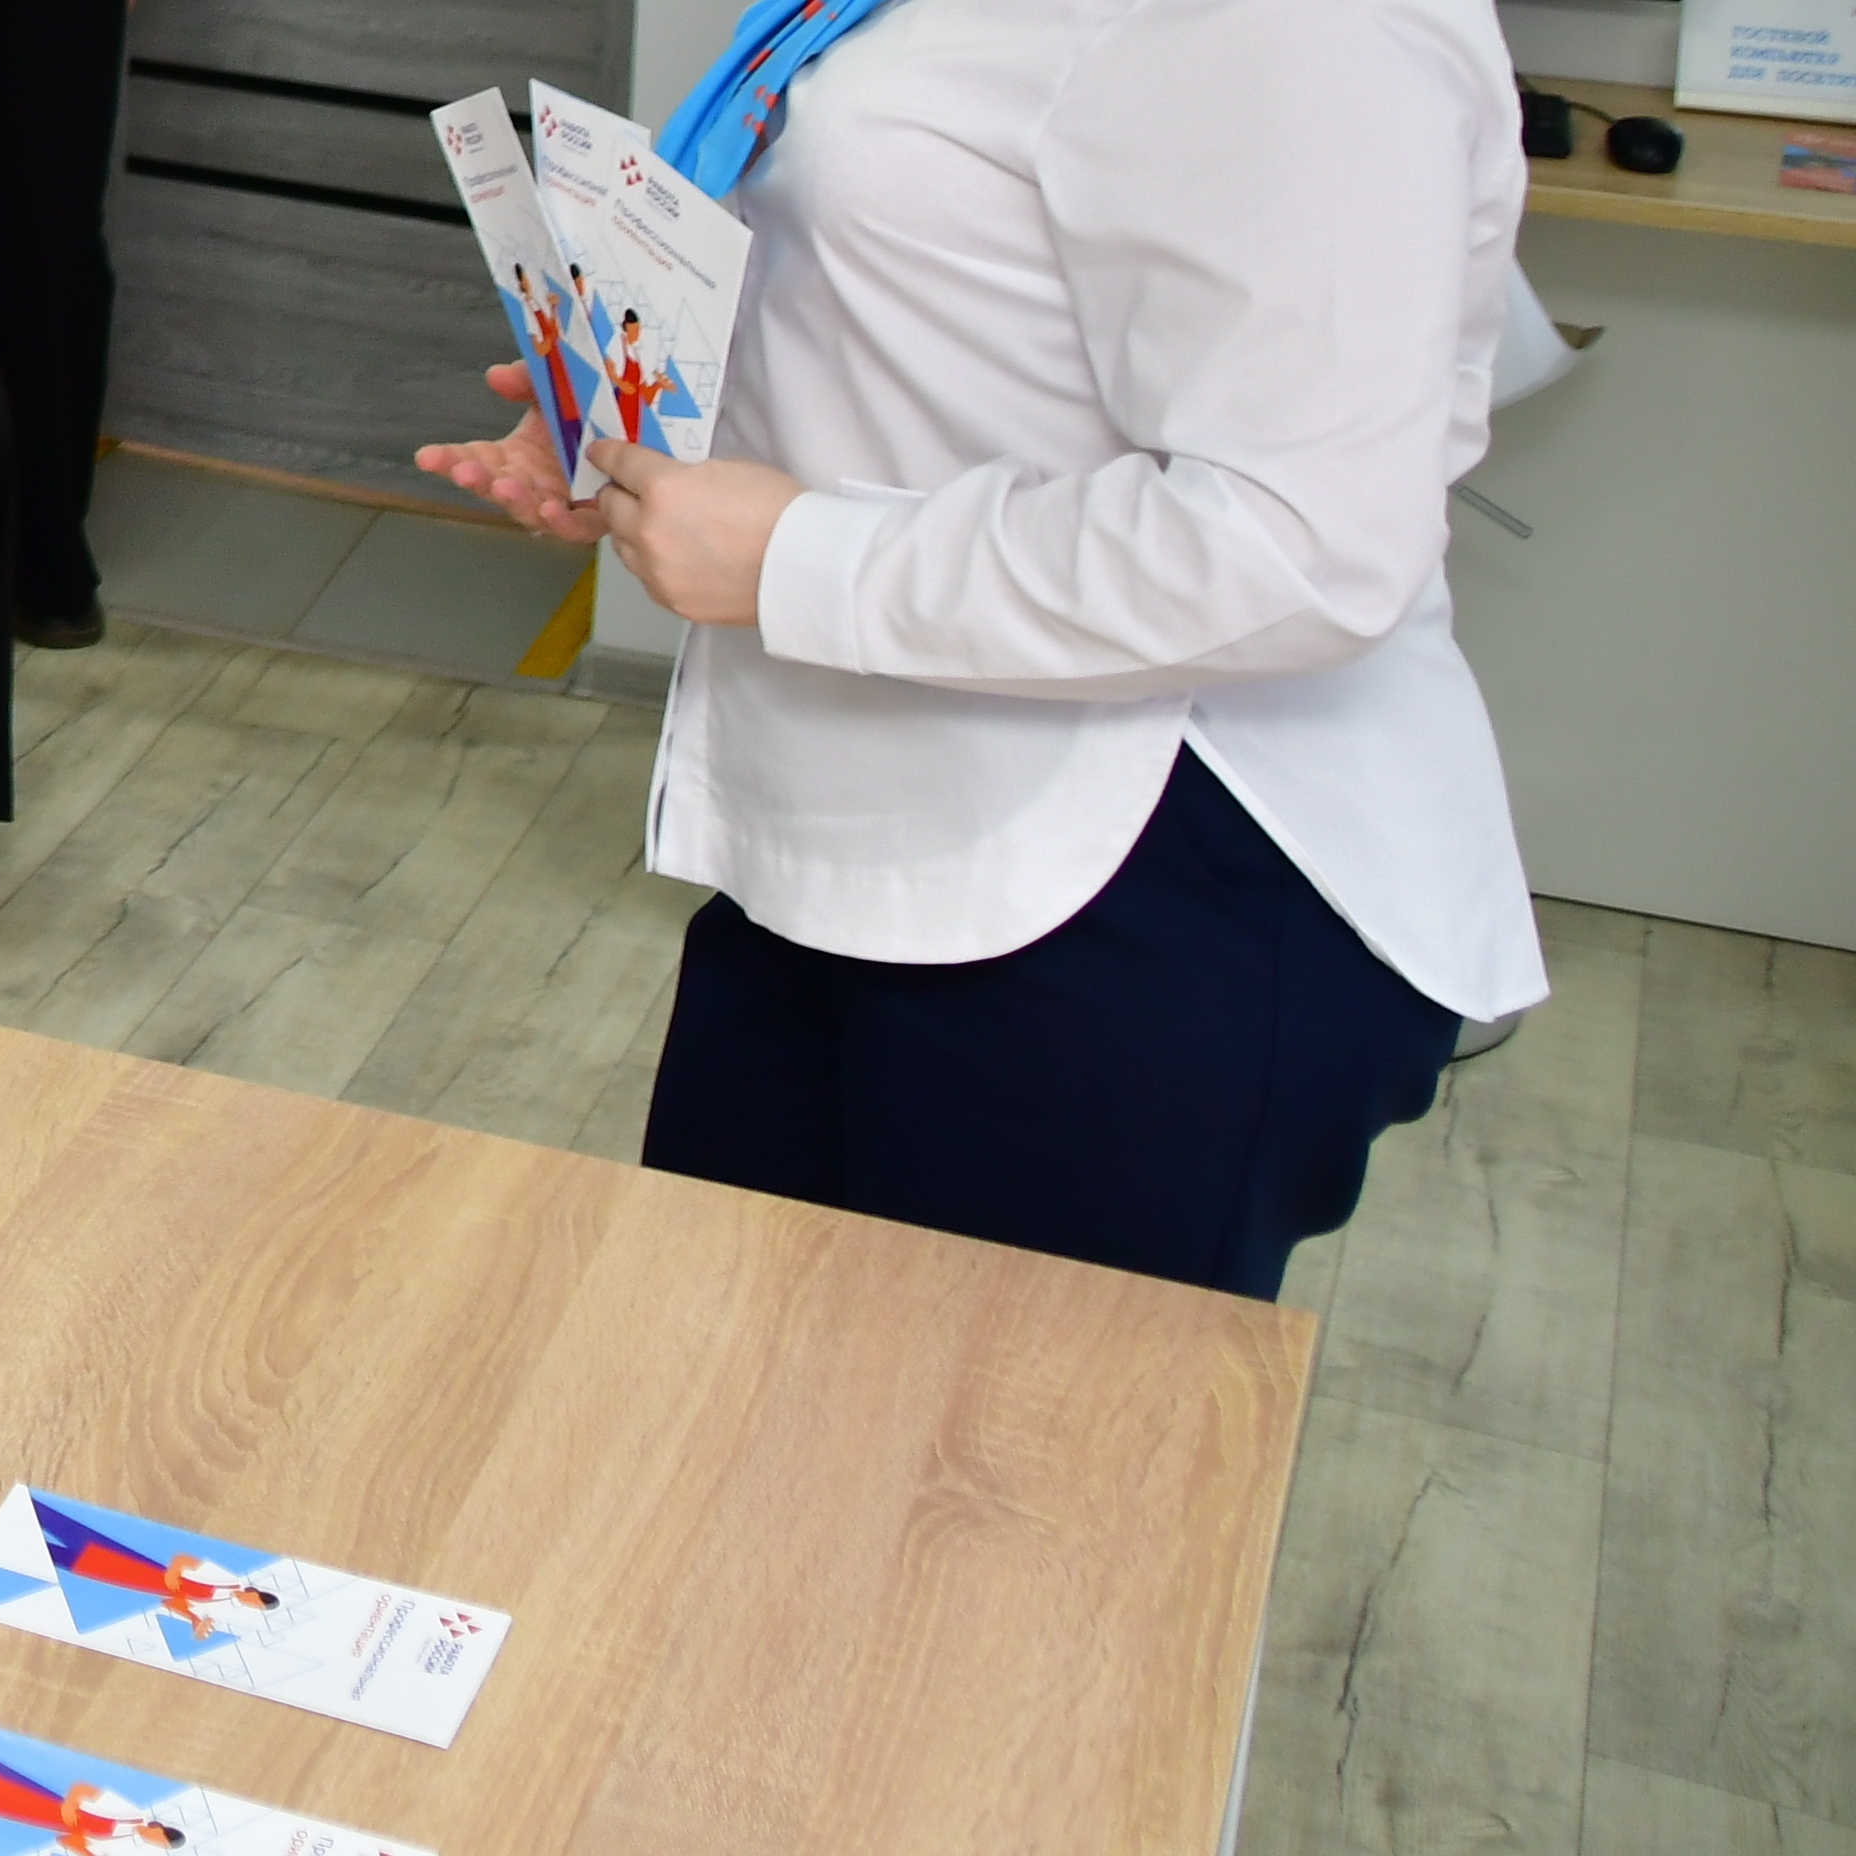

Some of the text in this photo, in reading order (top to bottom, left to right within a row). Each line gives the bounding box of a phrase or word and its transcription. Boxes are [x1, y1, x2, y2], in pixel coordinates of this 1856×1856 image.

[1732, 24, 1831, 45] ГОСТЕВОЙ
[1727, 65, 1766, 79] ДЛЯ
[1730, 45, 1842, 66] КОМПЬЮТЕР
[613, 197, 718, 291] Профессиональная
[351, 1593, 393, 1659] ориентация
[350, 1599, 416, 1702] Профессиональная
[423, 1638, 450, 1675] РОССИИ
[438, 1641, 464, 1676] РАБОТА
